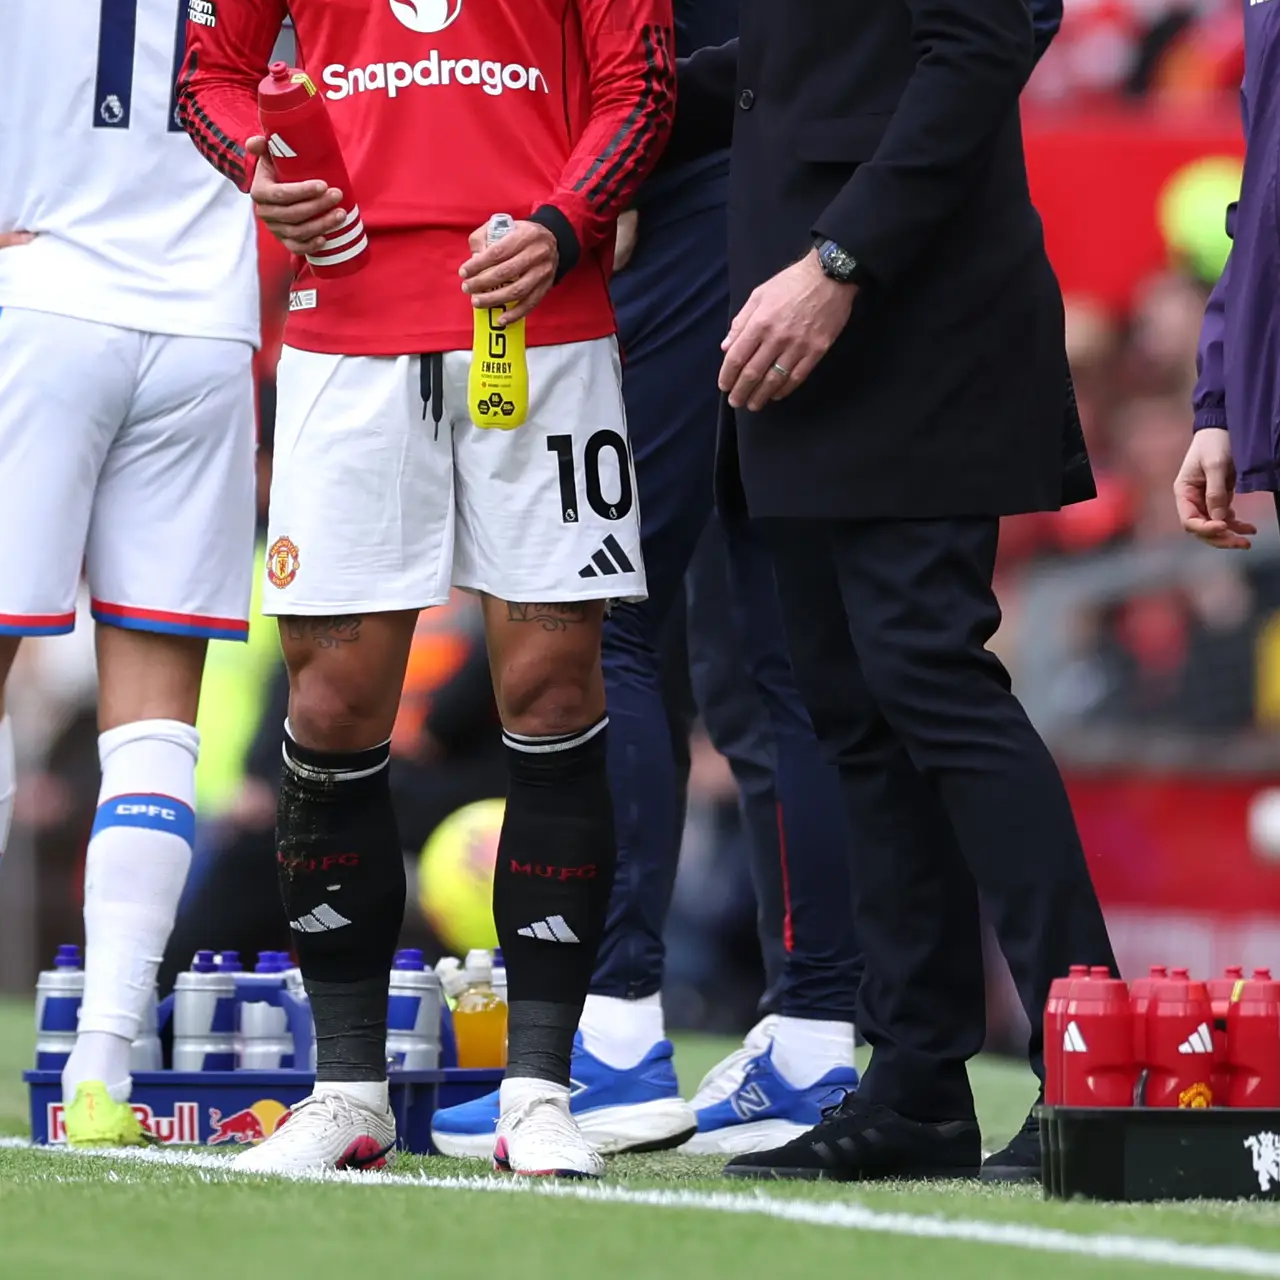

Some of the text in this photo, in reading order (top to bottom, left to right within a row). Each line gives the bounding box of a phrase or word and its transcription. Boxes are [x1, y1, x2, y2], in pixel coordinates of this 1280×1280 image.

[322, 49, 549, 101] Snapdragon
[481, 360, 513, 374] ENERGY
[546, 428, 634, 524] 10
[115, 803, 176, 821] CPFC
